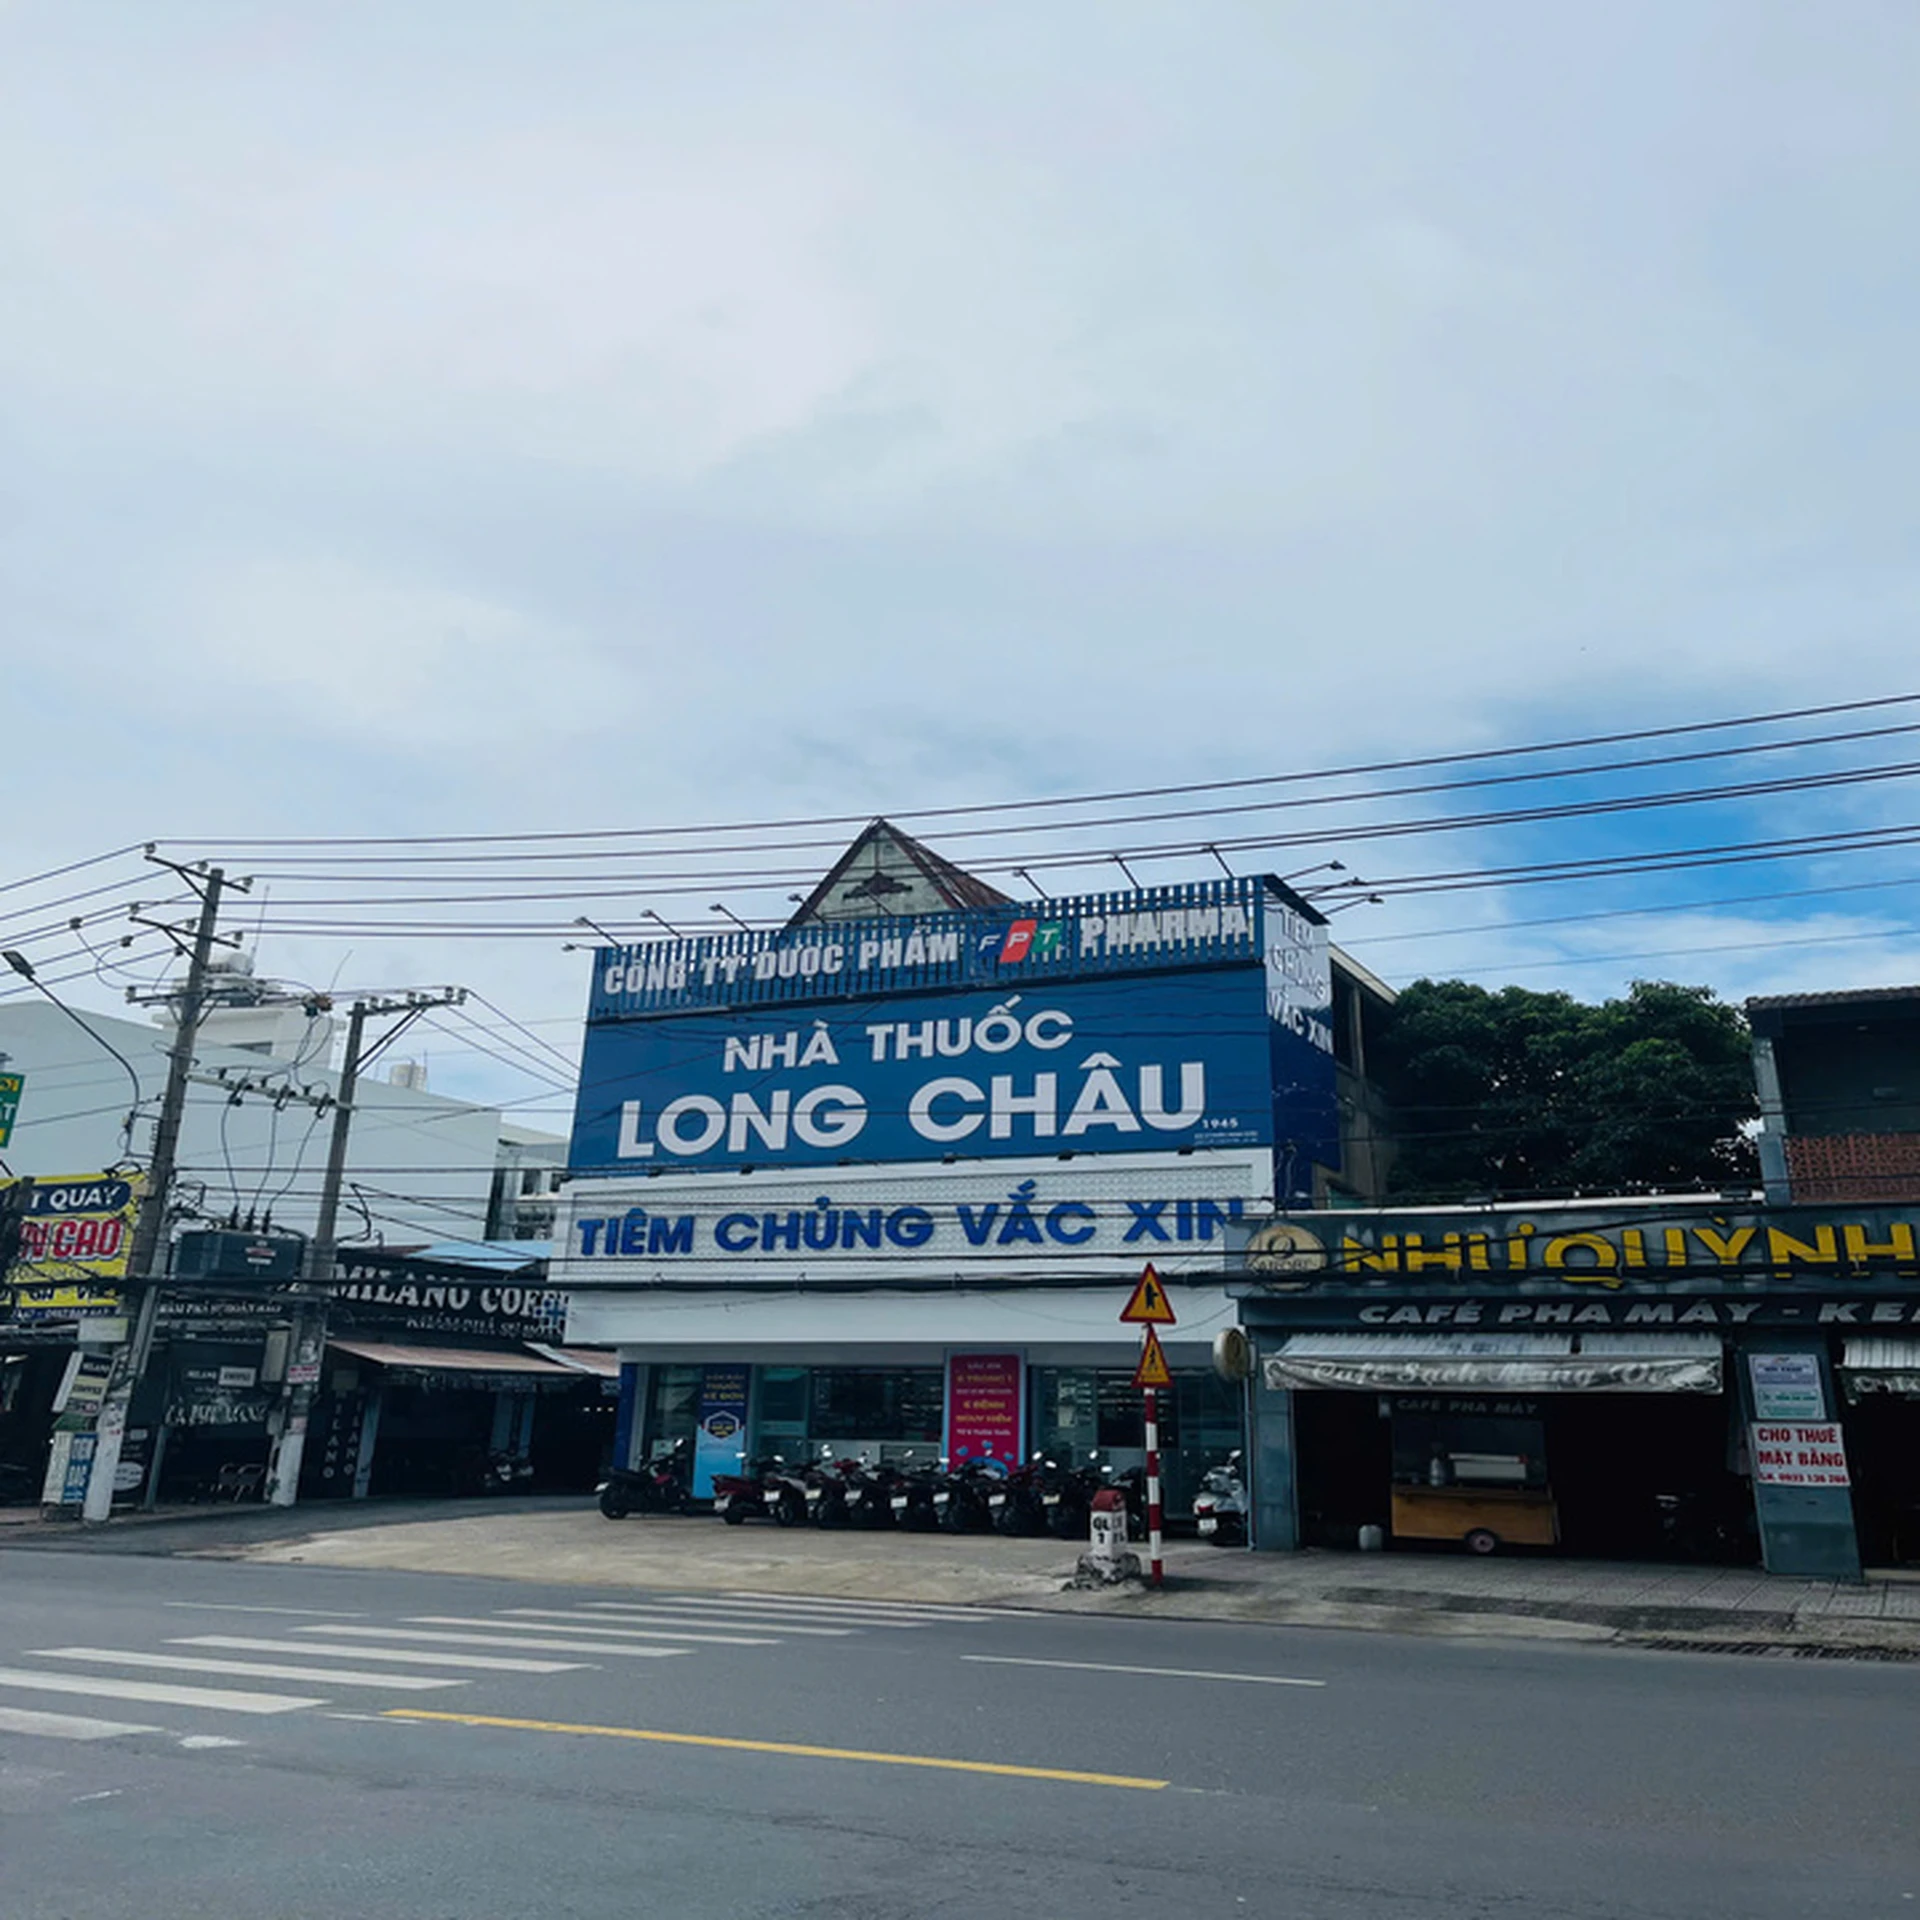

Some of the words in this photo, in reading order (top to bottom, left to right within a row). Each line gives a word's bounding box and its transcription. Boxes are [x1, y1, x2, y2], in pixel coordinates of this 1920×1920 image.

[604, 958, 687, 994] CÔNG
[701, 954, 744, 986] TY
[755, 943, 844, 983] DƯỢC
[858, 926, 959, 971] PHẨM
[976, 921, 1062, 957] FPT
[1080, 905, 1253, 954] PHARMA
[723, 1018, 840, 1074] NHÀ
[866, 994, 1075, 1063] THUỐC
[617, 1084, 868, 1159] LONG
[908, 1052, 1205, 1143] CHÂU
[1202, 1117, 1239, 1130] 1945
[49, 1186, 121, 1211] QUAY
[576, 1206, 696, 1258] TIÊM
[713, 1195, 936, 1253] CHỦNG
[956, 1178, 1099, 1247] VẮC
[1122, 1194, 1245, 1244] XIN
[52, 1218, 124, 1258] CAO
[325, 1262, 471, 1312] MILANO
[1358, 1299, 1483, 1324] CAFÉ
[1499, 1303, 1612, 1323] PHA
[1624, 1298, 1761, 1323] MÁY
[1818, 1302, 1920, 1323] KE
[1758, 1427, 1791, 1443] CHO
[1796, 1427, 1838, 1444] THUÊ
[1758, 1450, 1793, 1470] MẶT
[1799, 1448, 1844, 1468] BẰNG
